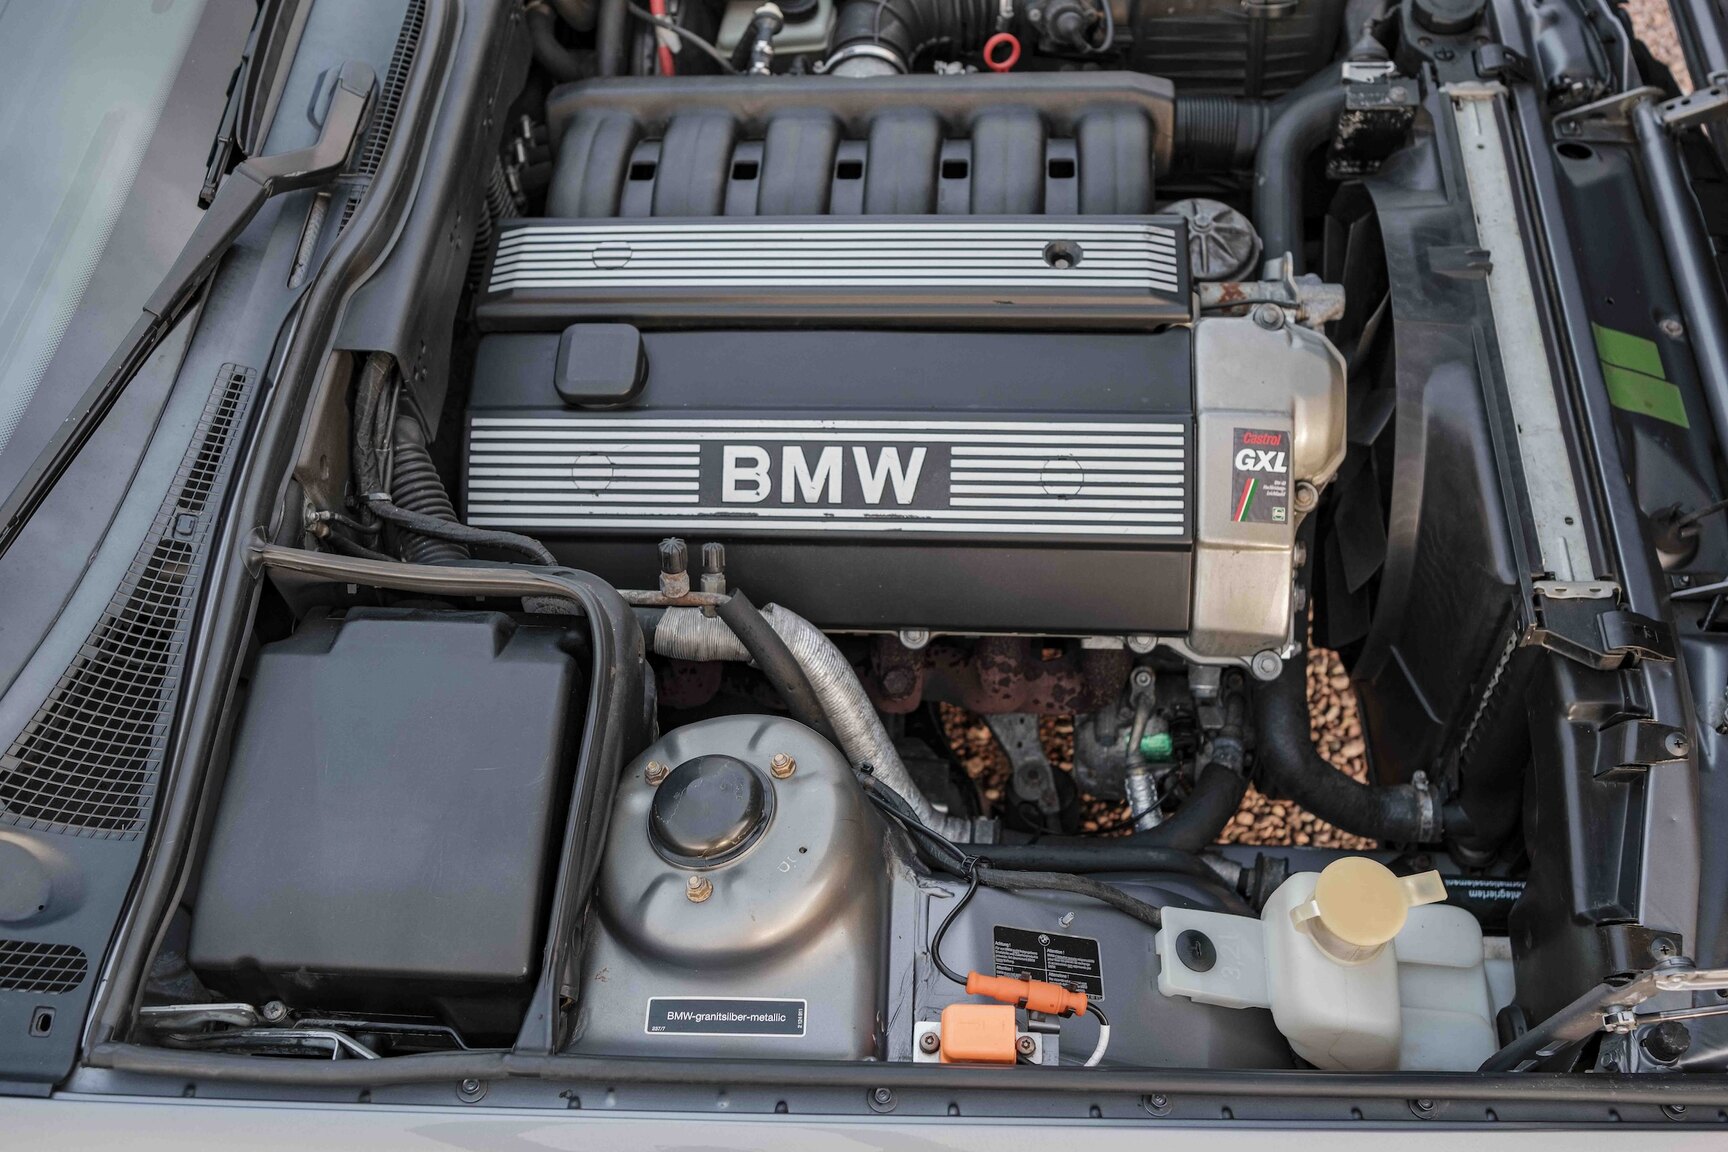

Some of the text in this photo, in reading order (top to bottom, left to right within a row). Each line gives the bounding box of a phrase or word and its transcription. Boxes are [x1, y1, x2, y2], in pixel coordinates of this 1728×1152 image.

[1243, 432, 1281, 446] Castrol
[1235, 448, 1287, 473] GXL
[721, 445, 928, 505] BMW
[667, 1011, 787, 1023] BMW-granitsilber-metallic
